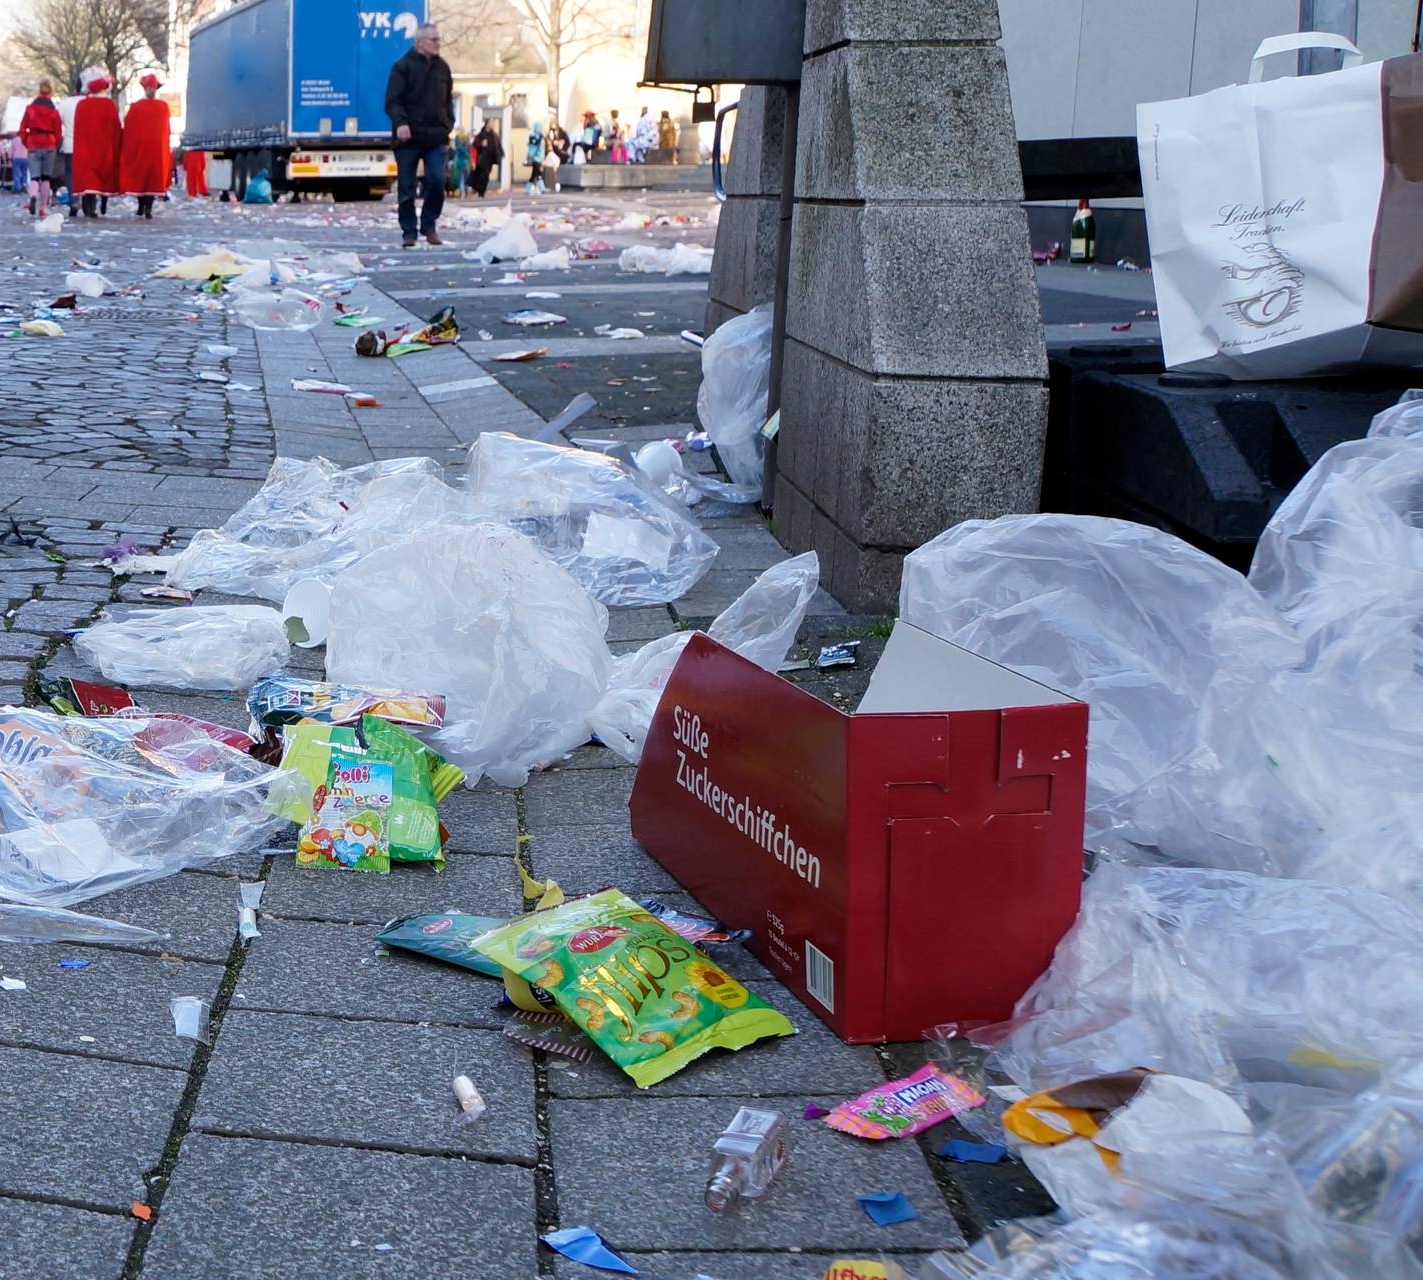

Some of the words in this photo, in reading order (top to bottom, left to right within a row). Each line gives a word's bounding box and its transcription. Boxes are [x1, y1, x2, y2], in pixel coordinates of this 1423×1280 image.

[673, 705, 709, 759] Süße
[676, 749, 820, 889] Zuckerschiffchen
[898, 1077, 948, 1104] MAOAM
